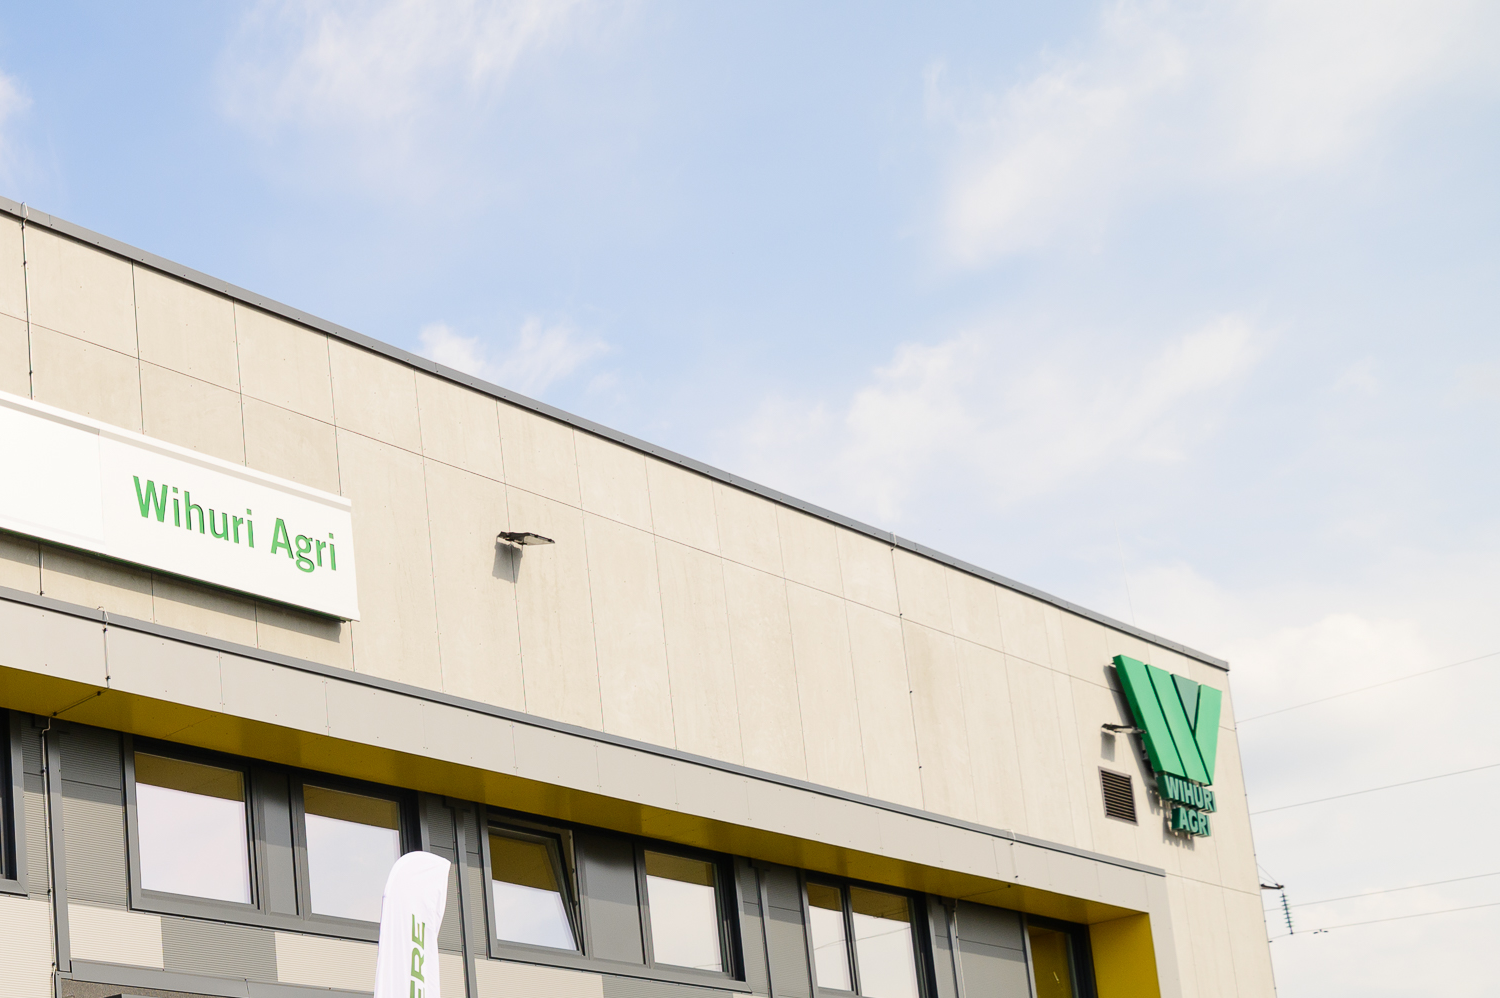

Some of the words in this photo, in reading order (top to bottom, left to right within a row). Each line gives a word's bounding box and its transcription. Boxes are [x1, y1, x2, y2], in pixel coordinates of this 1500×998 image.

[133, 475, 255, 548] Wihuri
[270, 517, 337, 573] Agri
[1163, 774, 1217, 813] WIHURI
[1176, 806, 1212, 838] AGRI
